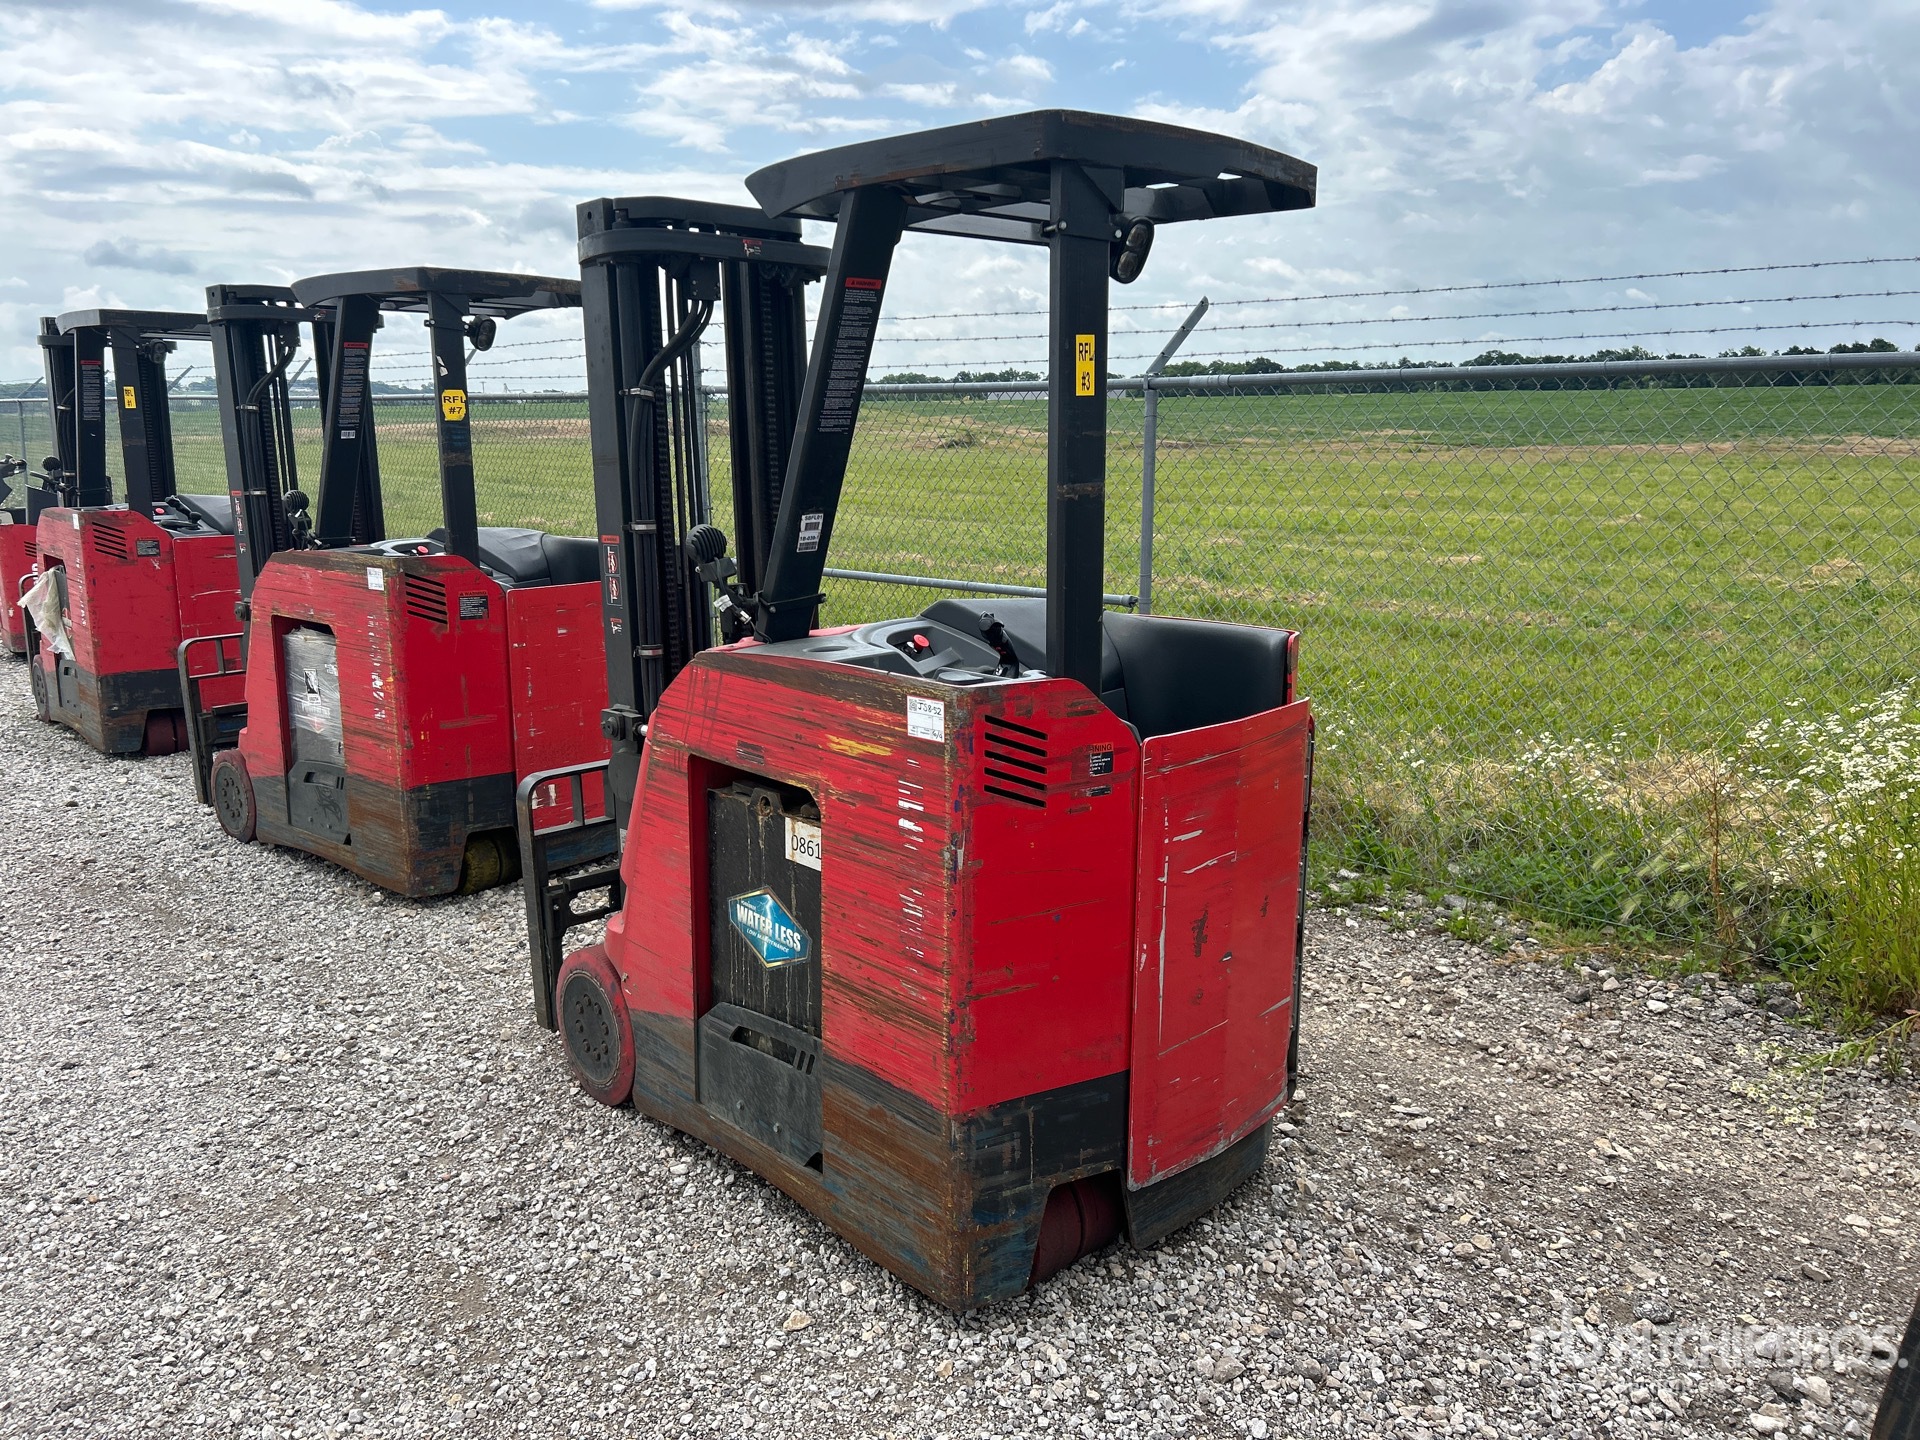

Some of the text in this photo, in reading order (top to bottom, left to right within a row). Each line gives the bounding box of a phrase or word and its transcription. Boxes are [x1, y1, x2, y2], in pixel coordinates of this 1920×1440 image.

[1078, 342, 1094, 362] RFL
[1081, 371, 1091, 391] #3
[443, 395, 466, 404] RFL
[449, 406, 463, 415] #7
[736, 903, 801, 953] WATER LESS
[746, 928, 757, 937] LOW
